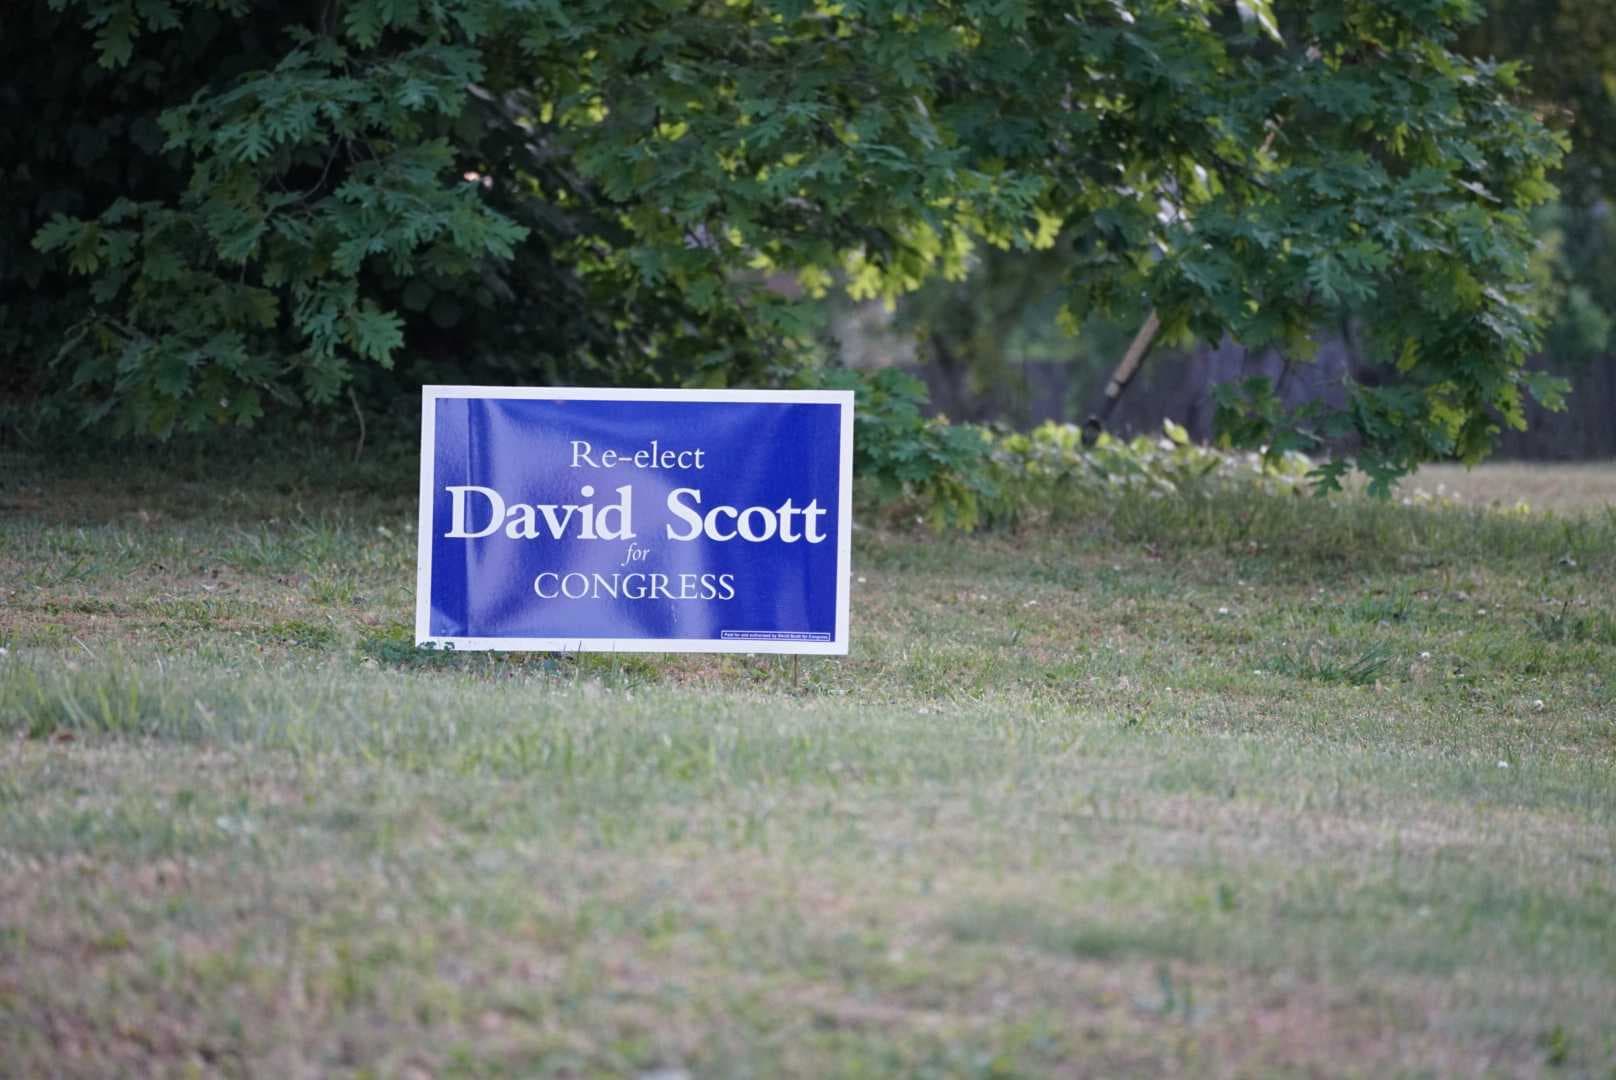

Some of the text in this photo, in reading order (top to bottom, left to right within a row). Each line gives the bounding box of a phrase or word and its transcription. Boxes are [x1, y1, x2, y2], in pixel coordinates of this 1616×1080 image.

[569, 440, 705, 470] Re-elect
[444, 483, 828, 544] David Scott
[620, 543, 650, 566] for
[533, 572, 736, 601] CONGRESS
